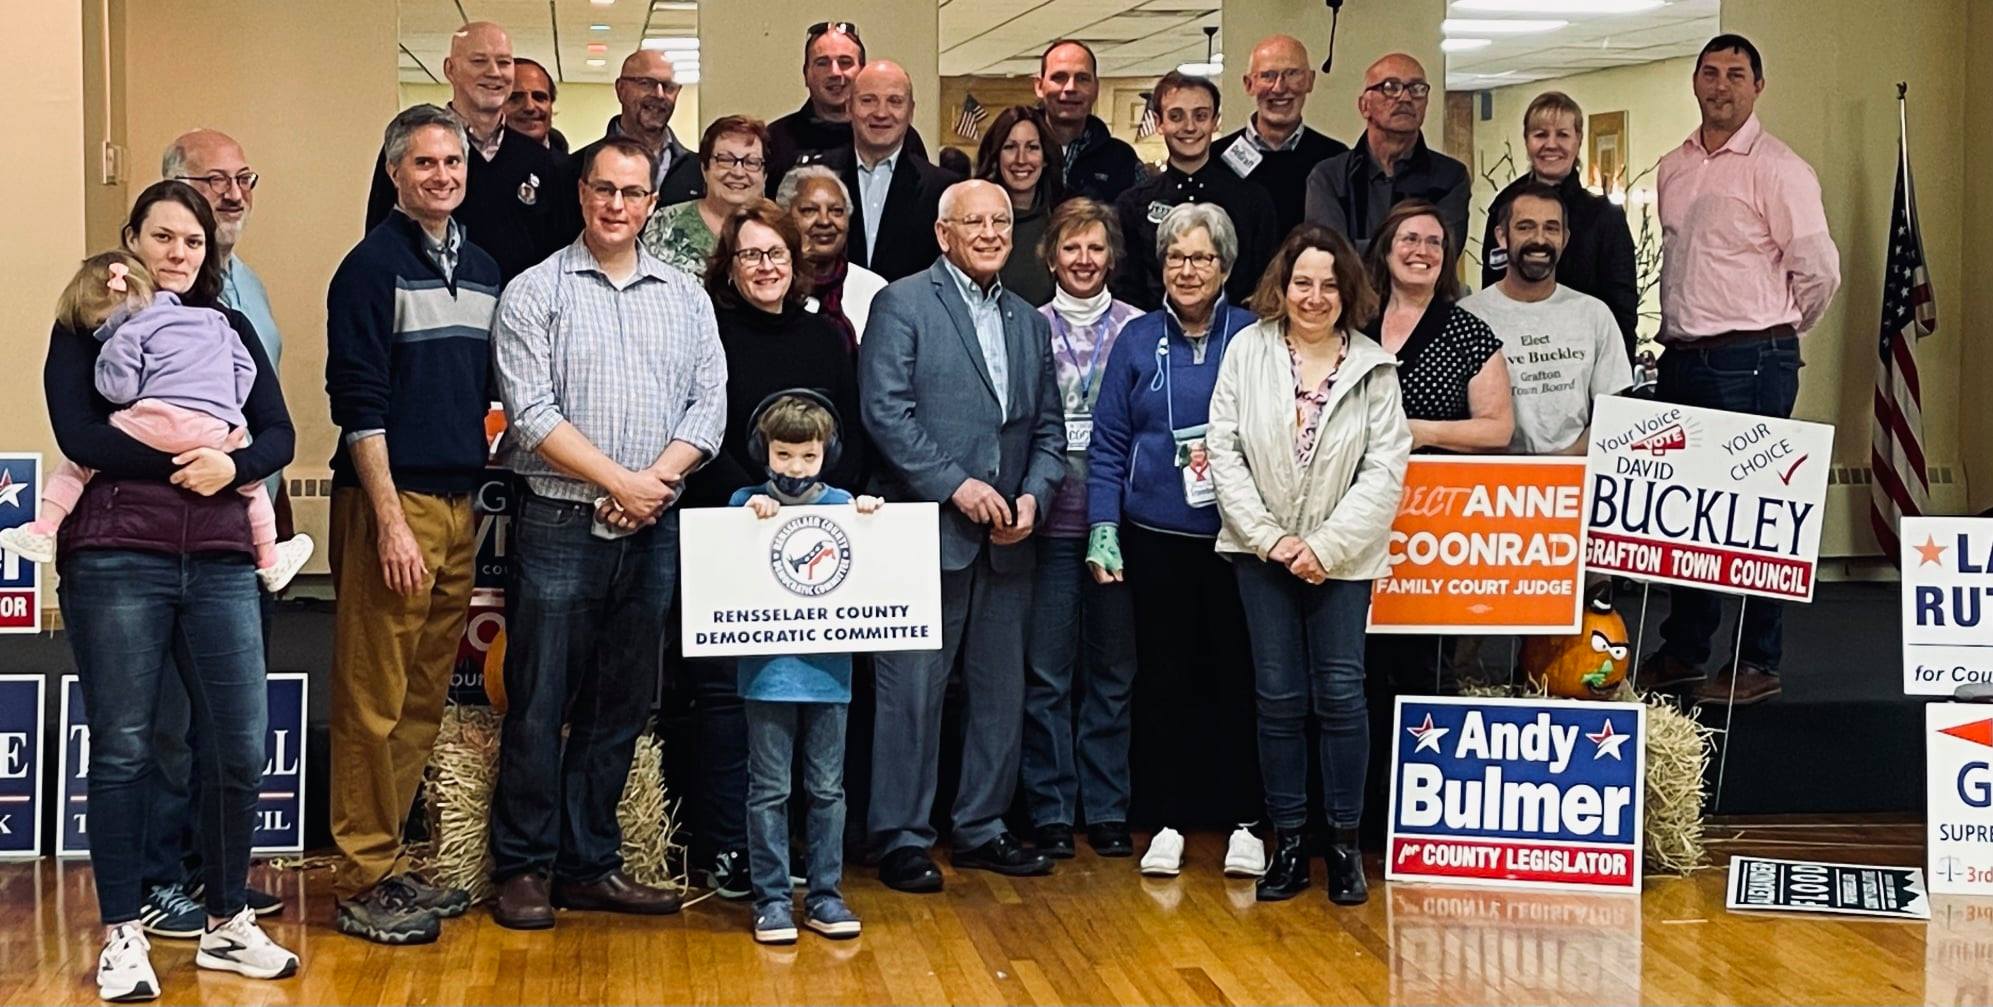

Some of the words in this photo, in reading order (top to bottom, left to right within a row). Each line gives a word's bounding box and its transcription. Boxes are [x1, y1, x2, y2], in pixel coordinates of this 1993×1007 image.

[1507, 355, 1525, 365] ve
[1529, 347, 1586, 364] Buckley
[1520, 334, 1550, 346] Elect
[1511, 385, 1538, 396] Town
[1540, 379, 1576, 394] Board
[1520, 370, 1561, 382] Grafton
[1596, 431, 1635, 454] Your
[1635, 408, 1681, 435] Voice
[1642, 428, 1684, 451] VOTE
[1722, 422, 1771, 455] YOUR
[1616, 456, 1674, 480] DAVID
[1730, 438, 1793, 481] CHOICE
[1398, 485, 1472, 517] LECT
[1462, 484, 1581, 518] ANNE
[1588, 473, 1814, 555] BUCKLEY
[1386, 531, 1578, 567] COONRAD
[1957, 533, 1993, 574] L
[1585, 538, 1662, 573] GRAFTON
[1671, 549, 1722, 581] TOWN
[1730, 558, 1807, 594] COUNCIL
[1376, 579, 1444, 595] FAMILY
[1448, 579, 1510, 595] COURT
[1513, 580, 1572, 595] JUDGE
[713, 607, 828, 623] RENSSELAER
[836, 605, 909, 619] COUNTY
[696, 629, 816, 645] DEMOCRATIC
[823, 625, 929, 640] COMMITTEE
[1915, 665, 1945, 682] for
[1455, 710, 1579, 774] Andy
[1400, 762, 1631, 836] Bulmer
[1398, 843, 1421, 865] for
[1422, 843, 1501, 869] COUNTY
[1506, 847, 1627, 876] LEGISLATOR
[1747, 862, 1777, 905] ALEXANDER
[1789, 865, 1830, 908] FLOOD
